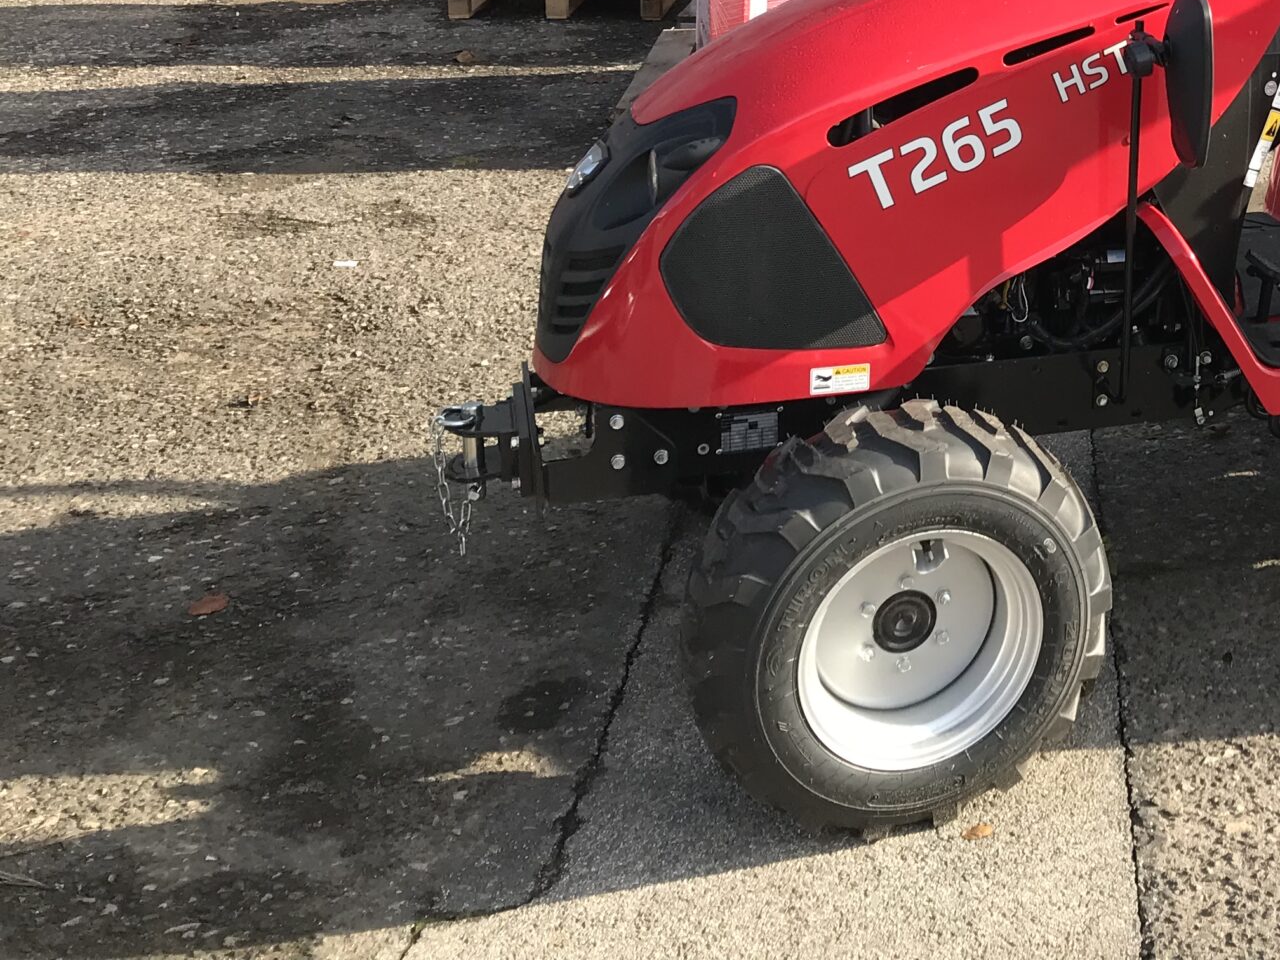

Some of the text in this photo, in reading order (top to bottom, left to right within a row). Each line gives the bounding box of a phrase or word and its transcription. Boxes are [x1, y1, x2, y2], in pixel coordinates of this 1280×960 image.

[1051, 39, 1129, 104] HST
[848, 98, 1023, 210] T265
[841, 367, 867, 375] CAUTION
